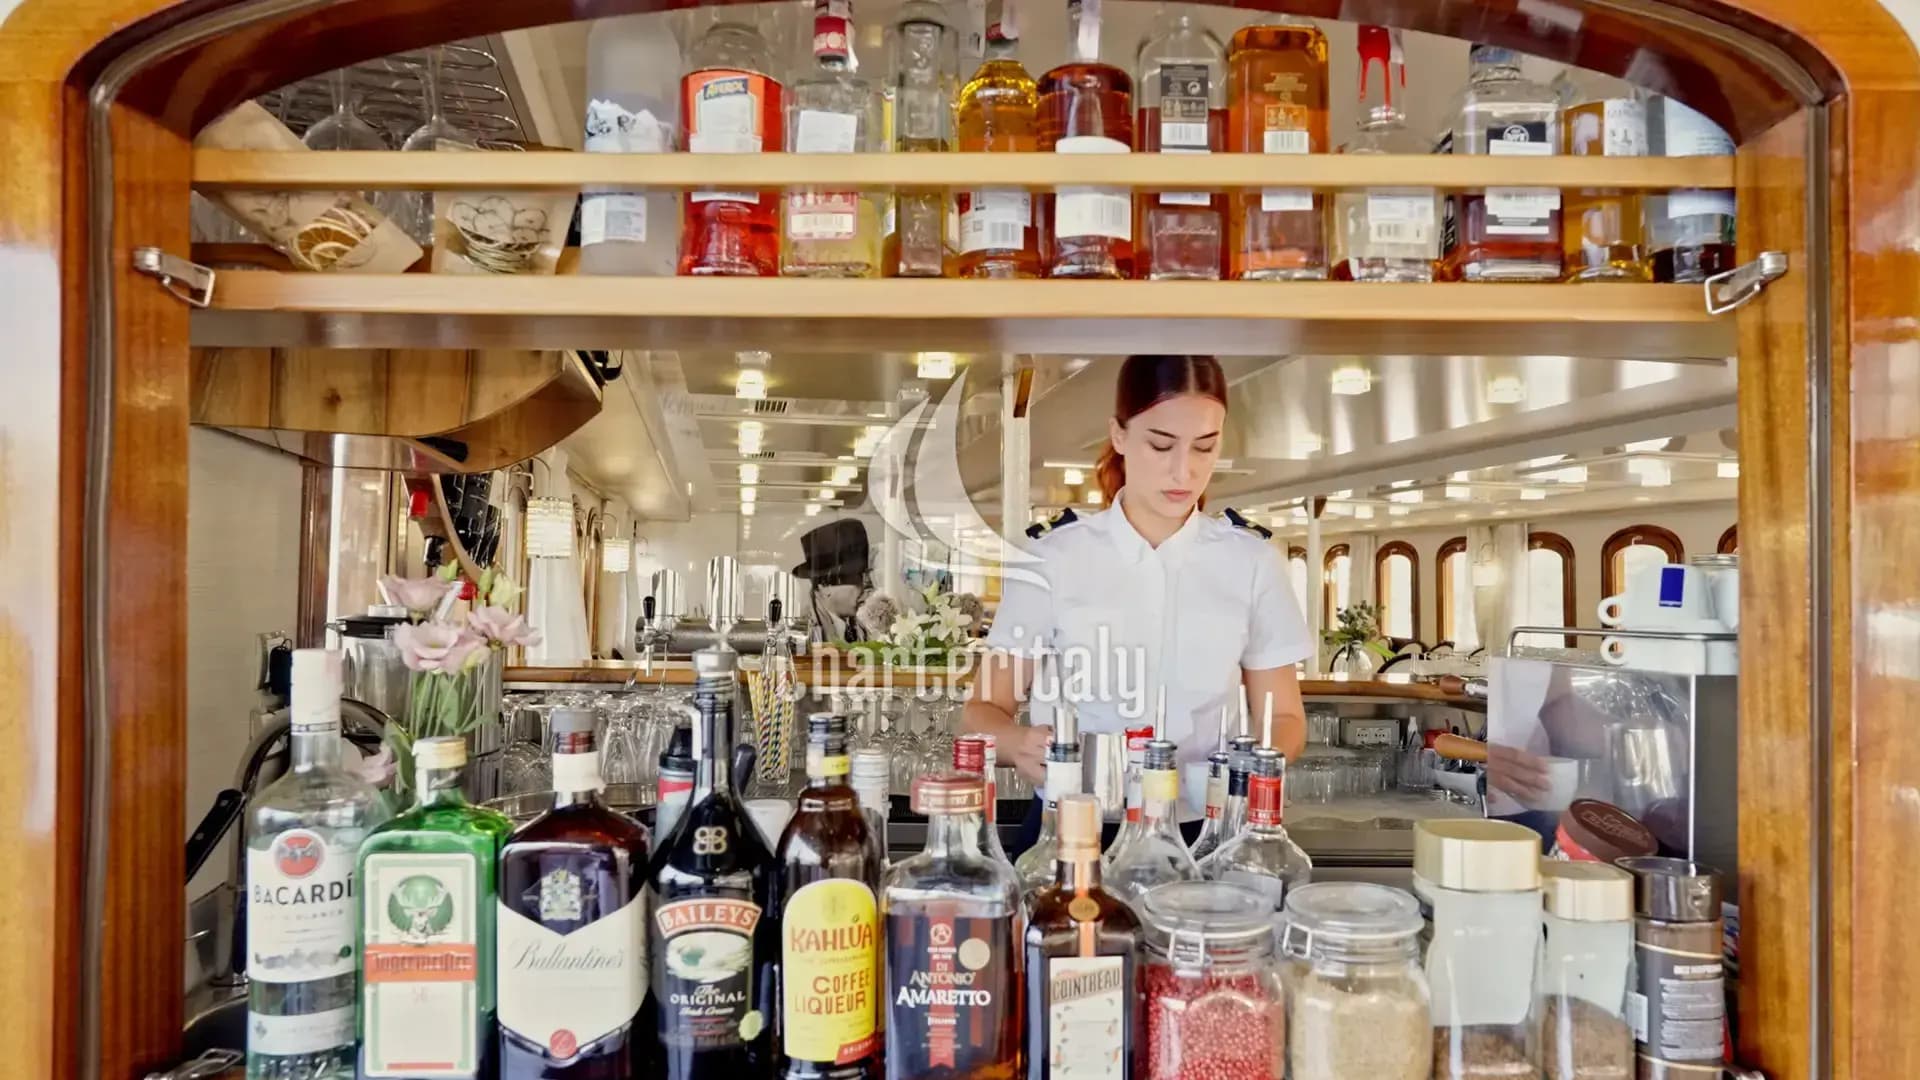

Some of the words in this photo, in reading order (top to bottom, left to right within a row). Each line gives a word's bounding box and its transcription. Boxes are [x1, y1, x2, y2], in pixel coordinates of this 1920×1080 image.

[661, 904, 755, 930] BAILEYS
[791, 914, 873, 953] KAHLÚA
[812, 967, 872, 995] COFFEE
[1052, 967, 1120, 1002] COINTREAU
[669, 990, 746, 1006] ORIGINAL
[795, 991, 866, 1015] LIQUEUR
[896, 985, 992, 1008] AMARETTO
